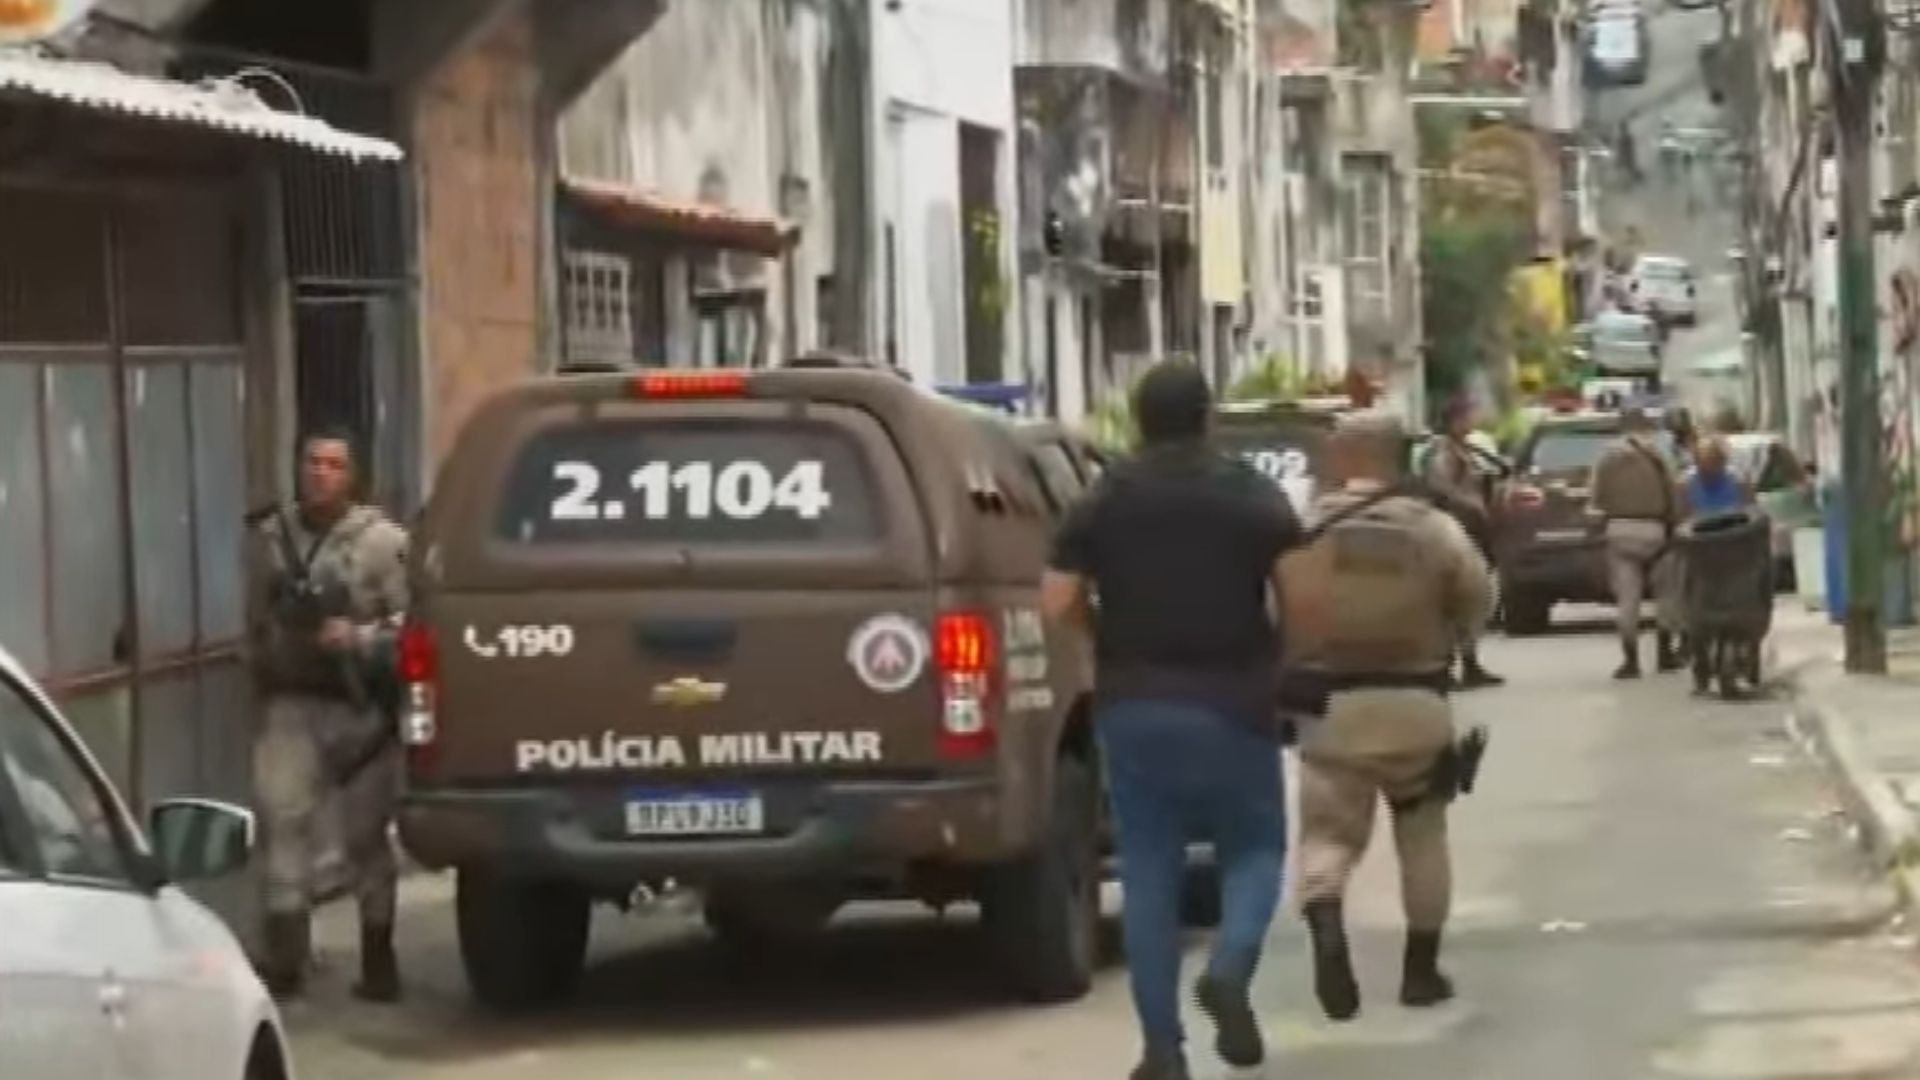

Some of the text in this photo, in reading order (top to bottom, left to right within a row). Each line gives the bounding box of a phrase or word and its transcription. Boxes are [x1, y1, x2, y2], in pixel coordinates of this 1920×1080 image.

[551, 461, 830, 519] 2.1104
[499, 624, 573, 657] 190
[516, 730, 882, 771] POLÍCIA MILITAR
